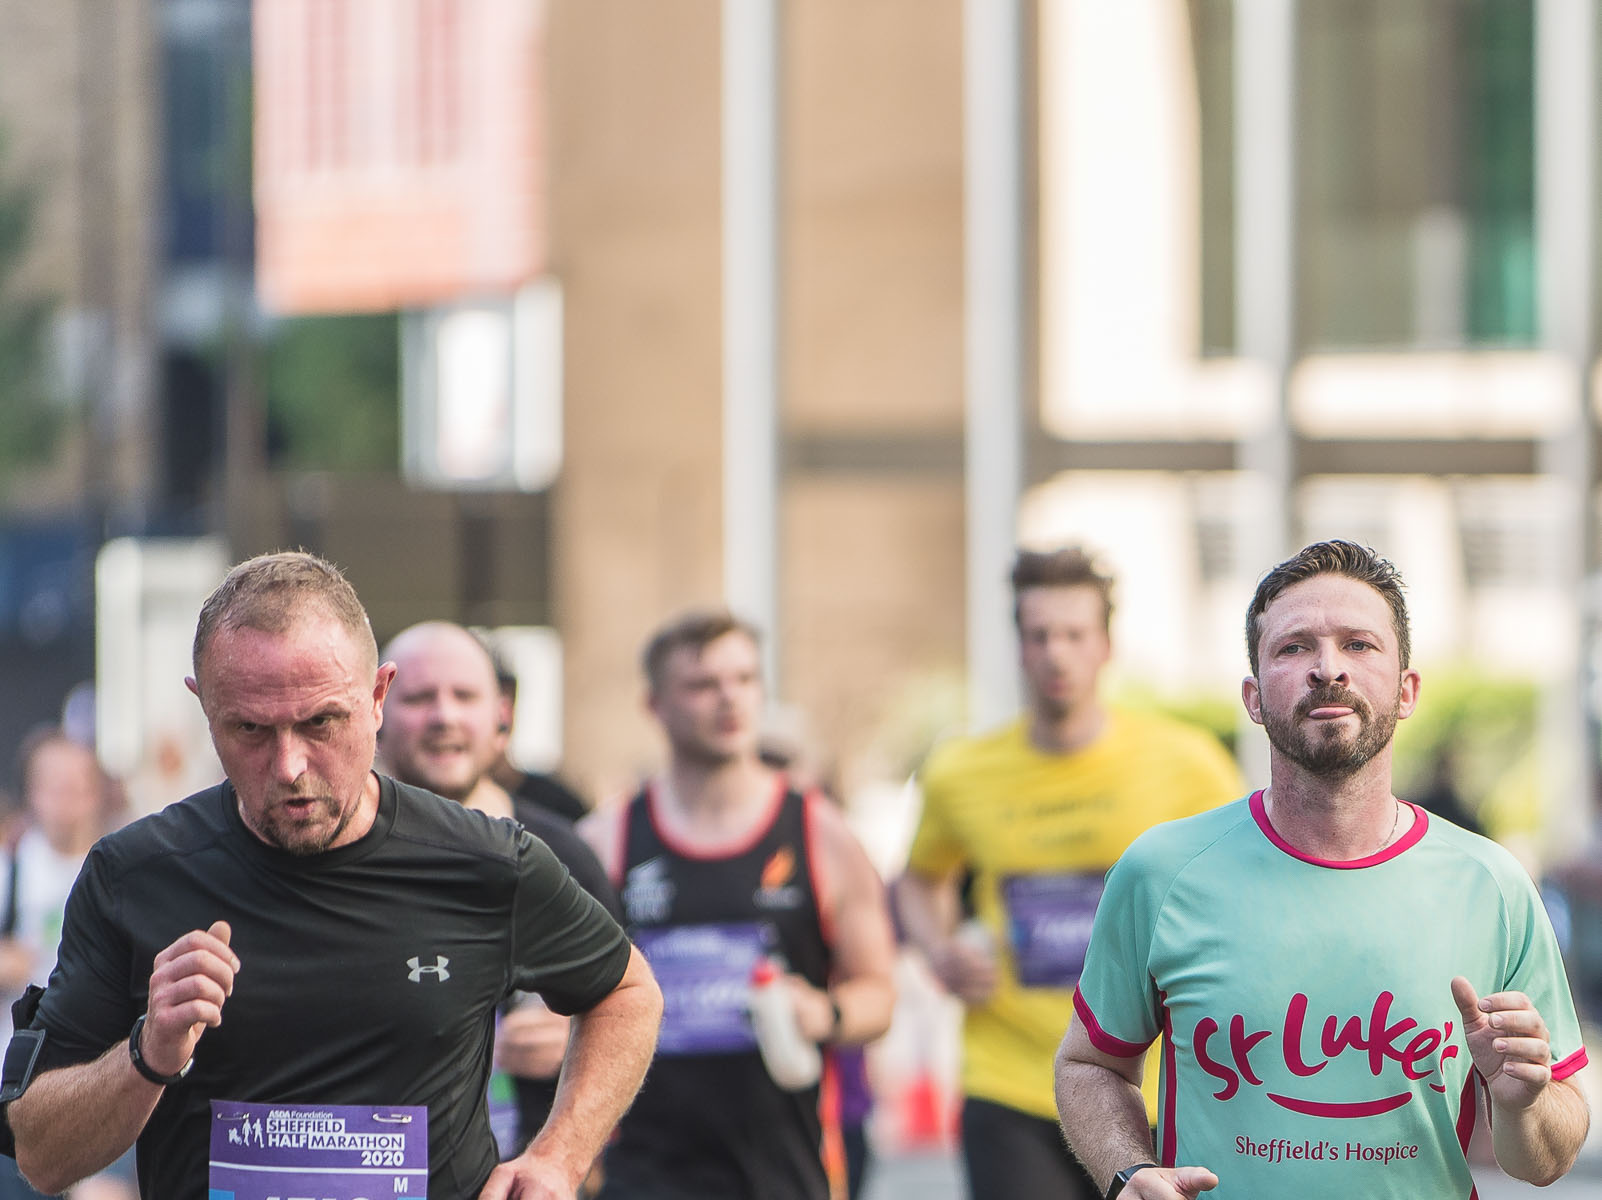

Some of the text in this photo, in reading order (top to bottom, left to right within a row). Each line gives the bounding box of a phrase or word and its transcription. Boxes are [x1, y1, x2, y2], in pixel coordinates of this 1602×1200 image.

[1193, 1014, 1272, 1101] St
[269, 1110, 333, 1119] ASDA Foundation
[268, 1120, 342, 1133] SHEFFIELD
[268, 1134, 402, 1148] HALF MARATHON
[1235, 1136, 1418, 1165] Sheffield's Hospice
[361, 1151, 404, 1166] 2020
[393, 1177, 408, 1193] M
